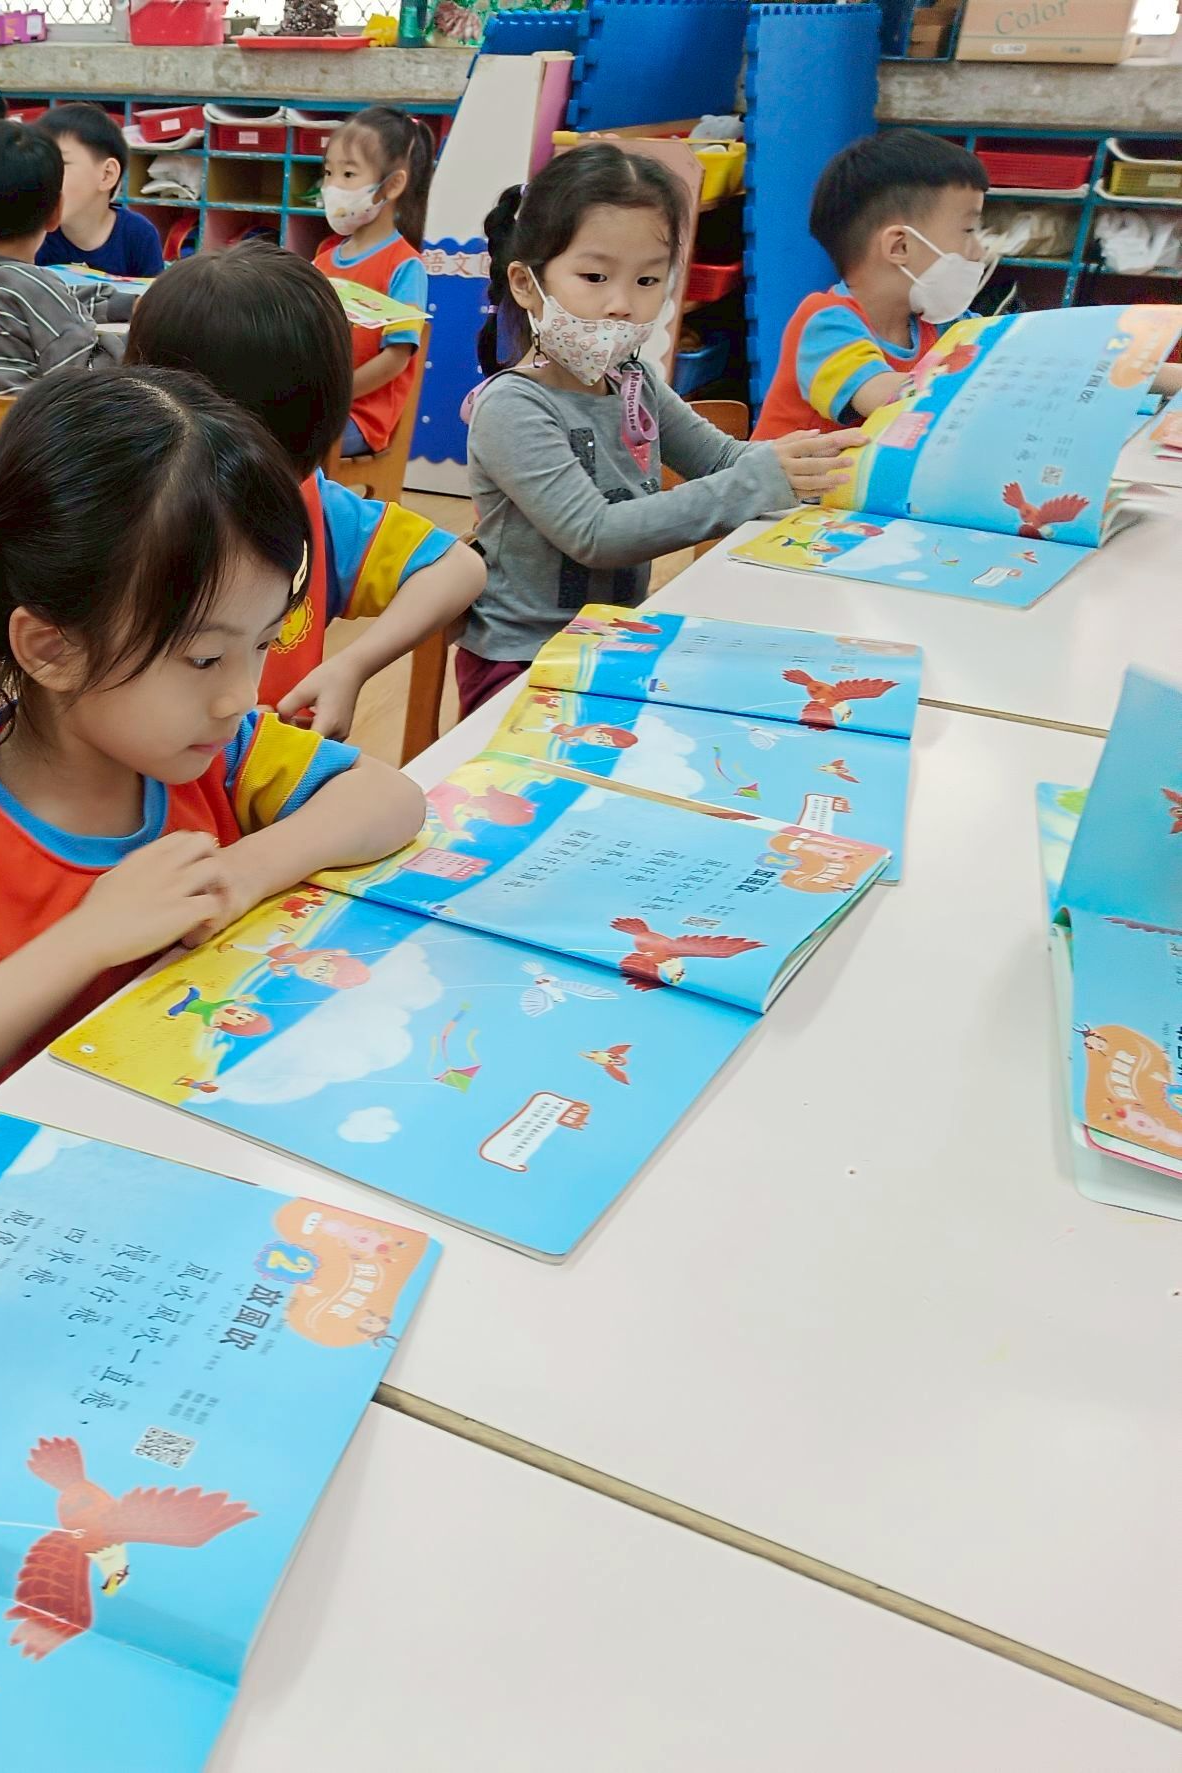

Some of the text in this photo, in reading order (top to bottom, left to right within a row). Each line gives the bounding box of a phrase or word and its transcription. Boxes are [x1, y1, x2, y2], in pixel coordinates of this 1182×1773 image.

[994, 0, 1069, 36] Color
[220, 1283, 284, 1351] 放風吹
